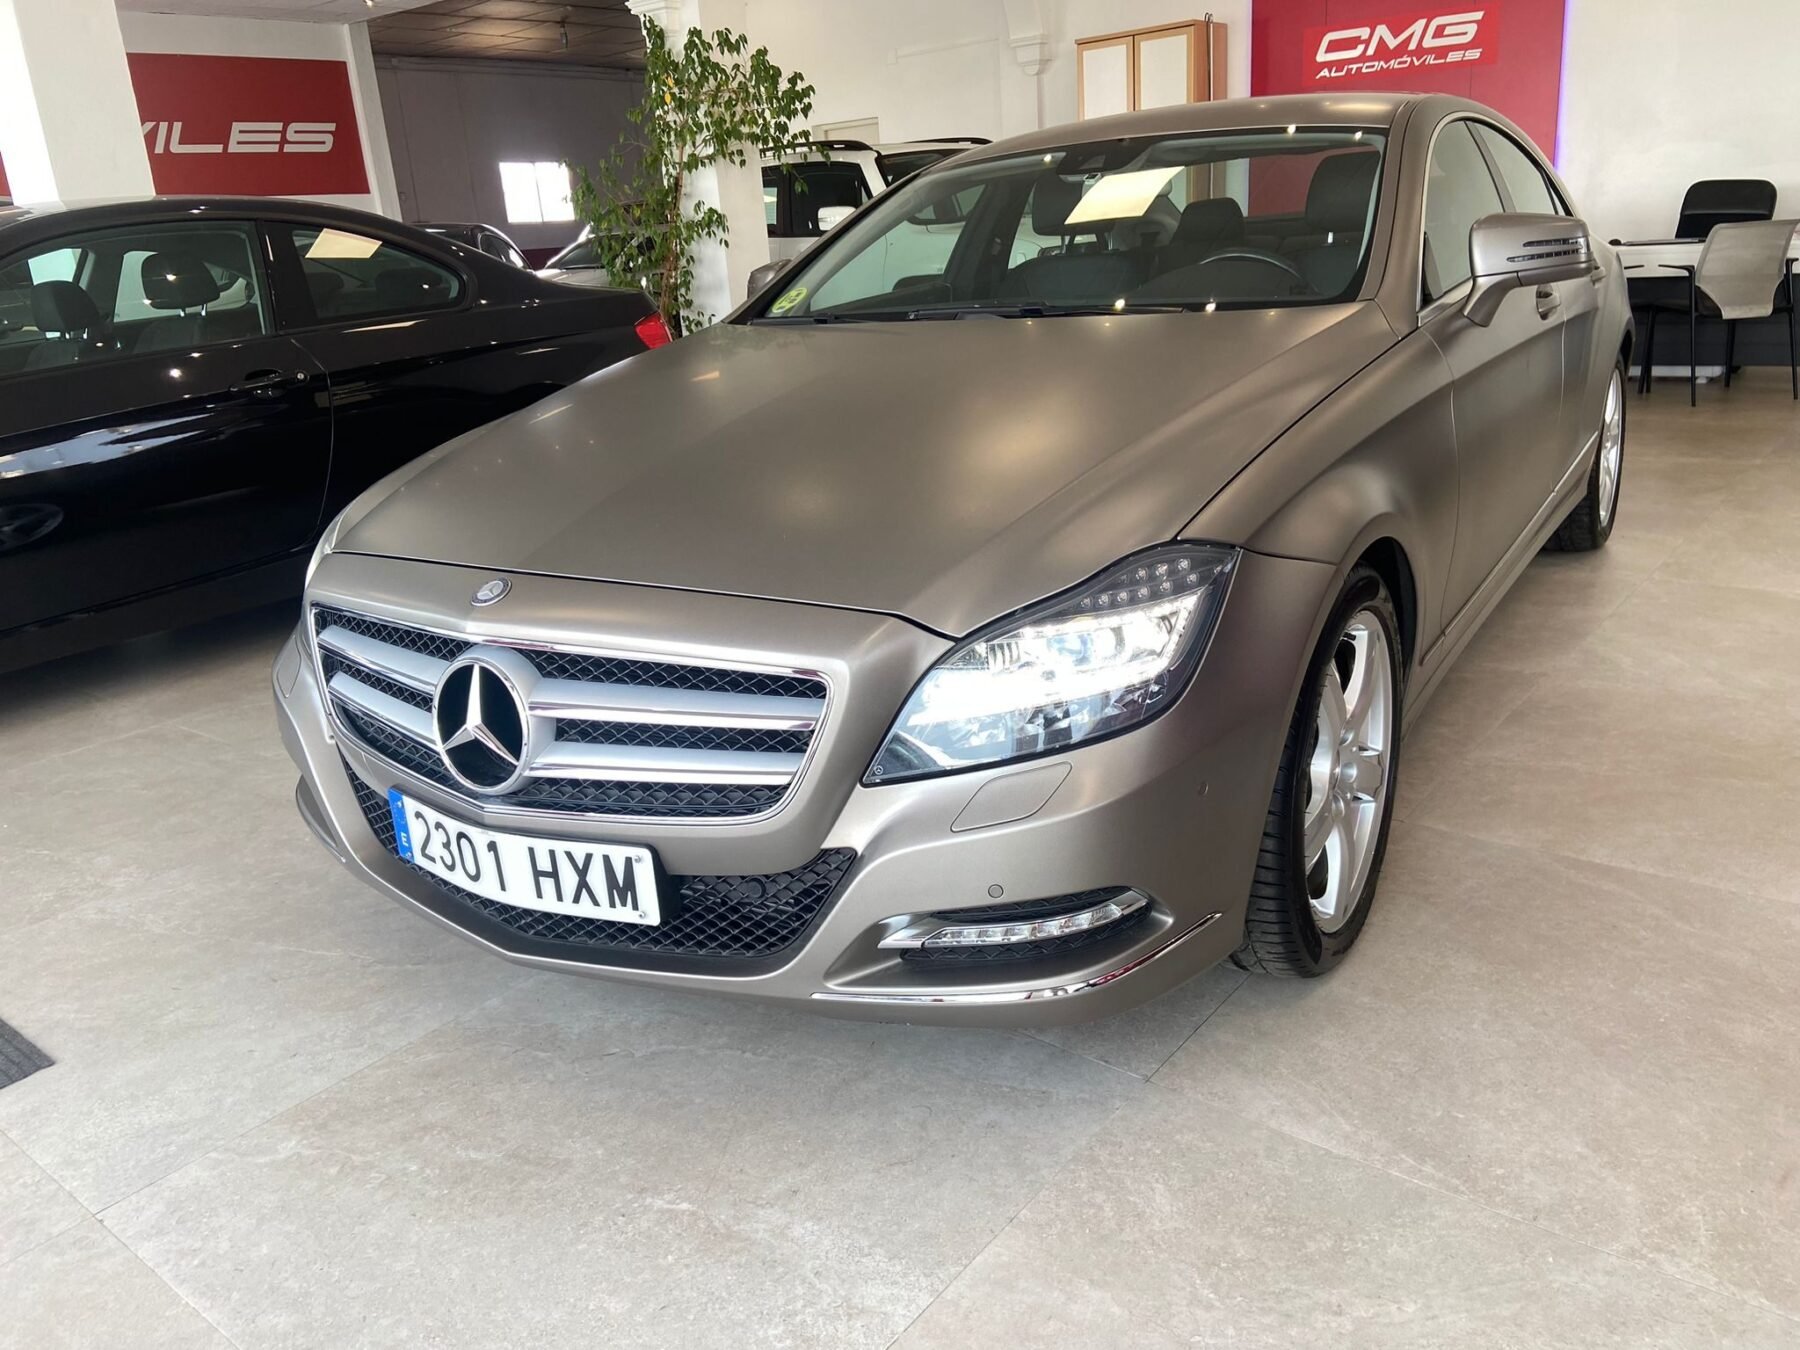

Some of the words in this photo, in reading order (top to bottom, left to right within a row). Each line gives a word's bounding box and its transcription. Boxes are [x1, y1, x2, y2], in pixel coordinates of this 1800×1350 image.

[1316, 11, 1485, 62] CMG
[1315, 48, 1483, 79] AUTOMÓVILES
[414, 810, 507, 892] 2301
[527, 846, 640, 912] HXM
